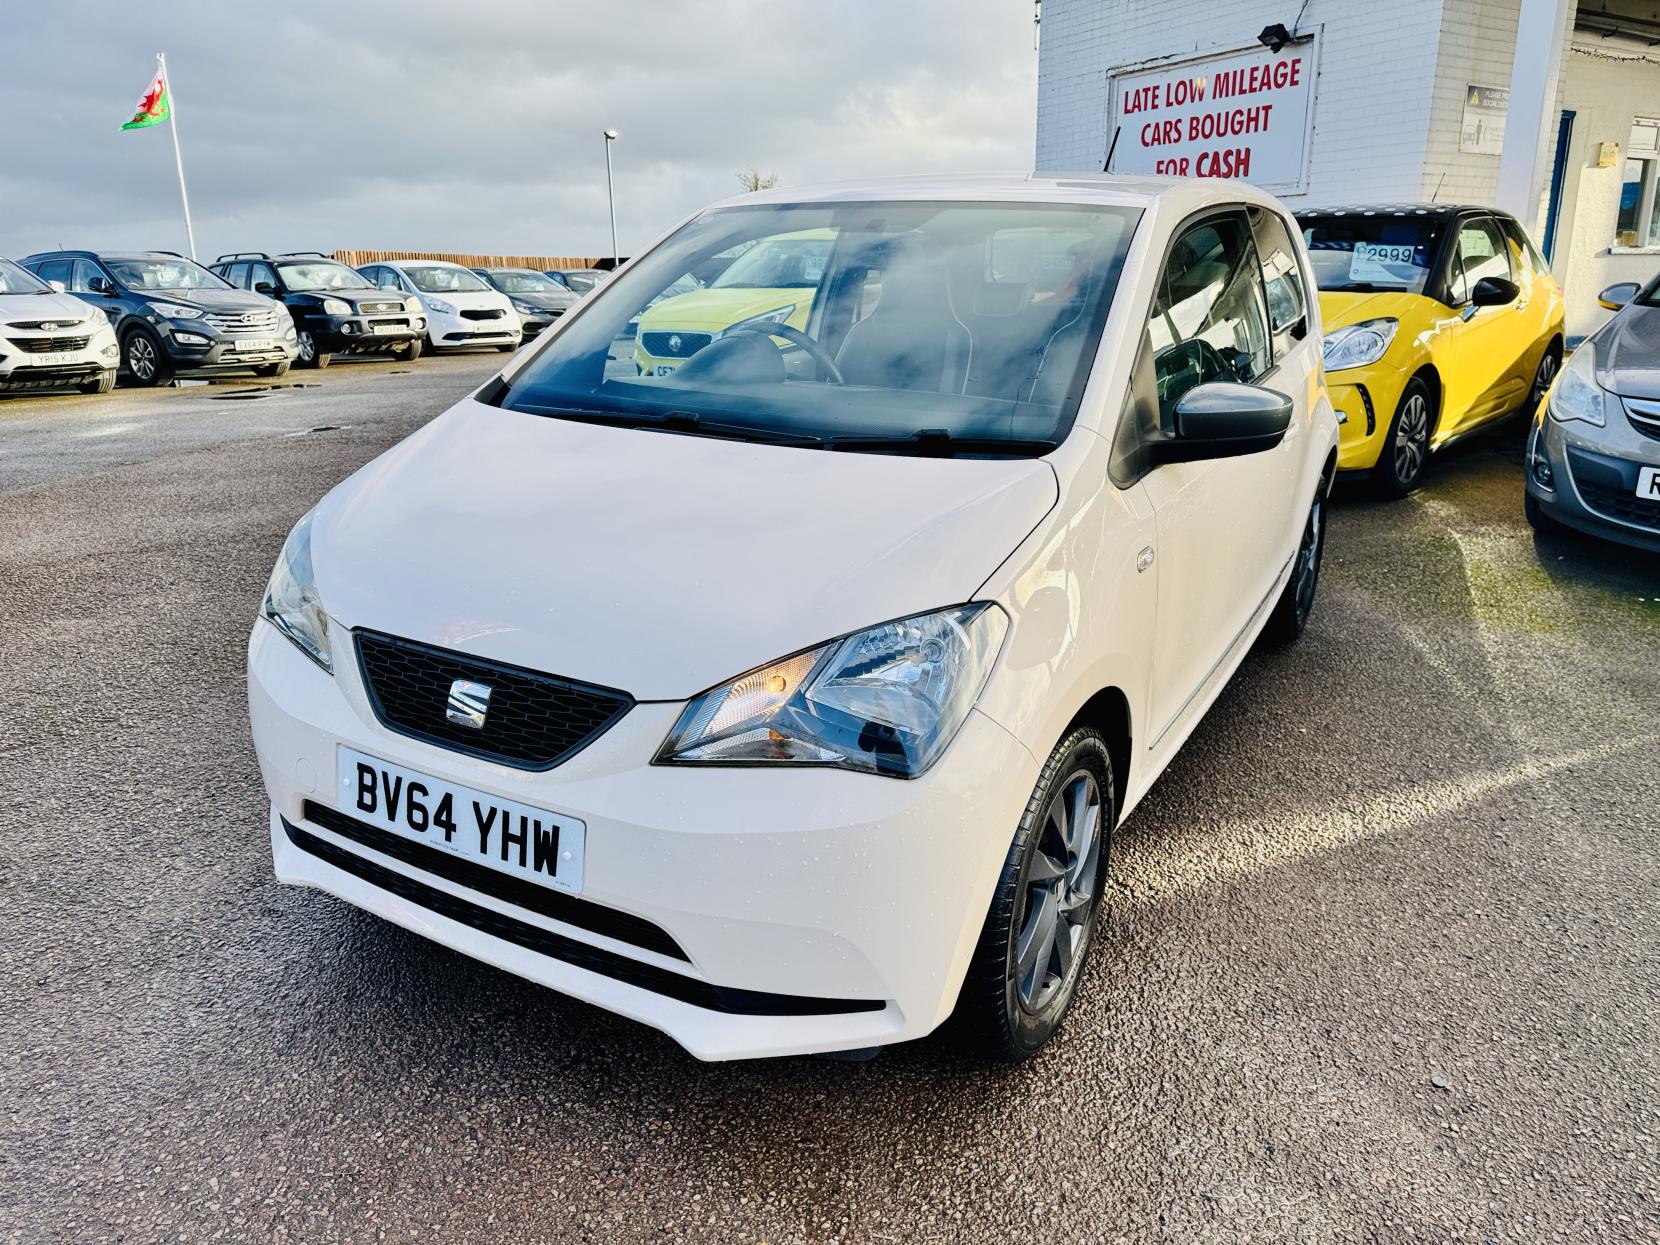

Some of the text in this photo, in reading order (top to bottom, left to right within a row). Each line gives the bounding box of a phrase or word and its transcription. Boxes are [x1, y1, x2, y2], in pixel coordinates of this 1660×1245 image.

[1124, 58, 1301, 114] LATE LOW MILEAGE
[1141, 104, 1272, 147] CARS BOUGHT
[1156, 147, 1251, 178] FOR CASH
[39, 353, 79, 364] YR15 KJU
[356, 762, 560, 878] BV64 YHW
